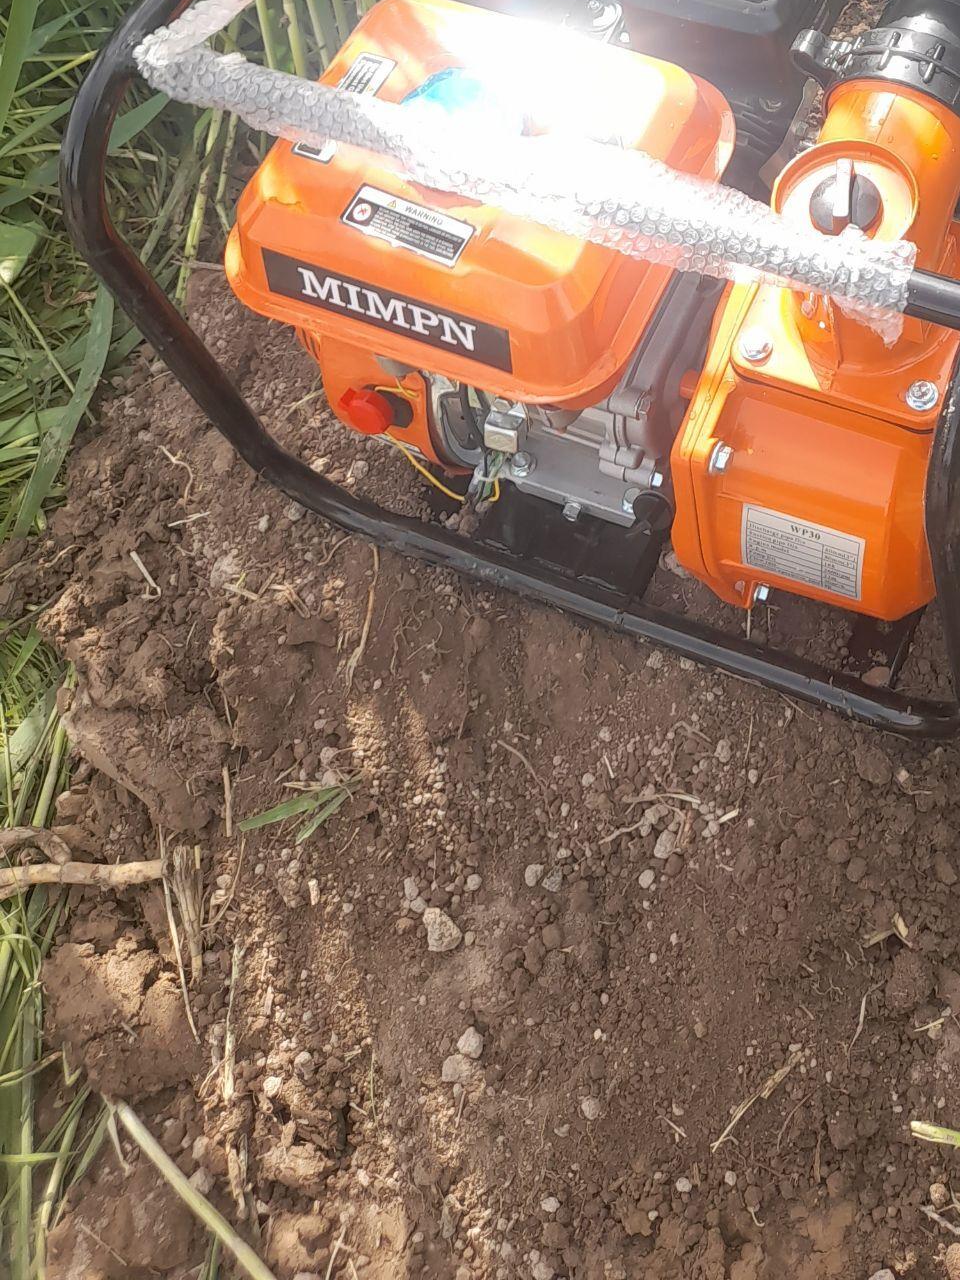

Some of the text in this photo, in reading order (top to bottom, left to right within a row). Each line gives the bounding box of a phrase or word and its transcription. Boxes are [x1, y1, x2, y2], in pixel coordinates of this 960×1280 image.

[404, 204, 444, 226] WARNING
[298, 267, 476, 352] MIMPN
[790, 524, 821, 541] WP30
